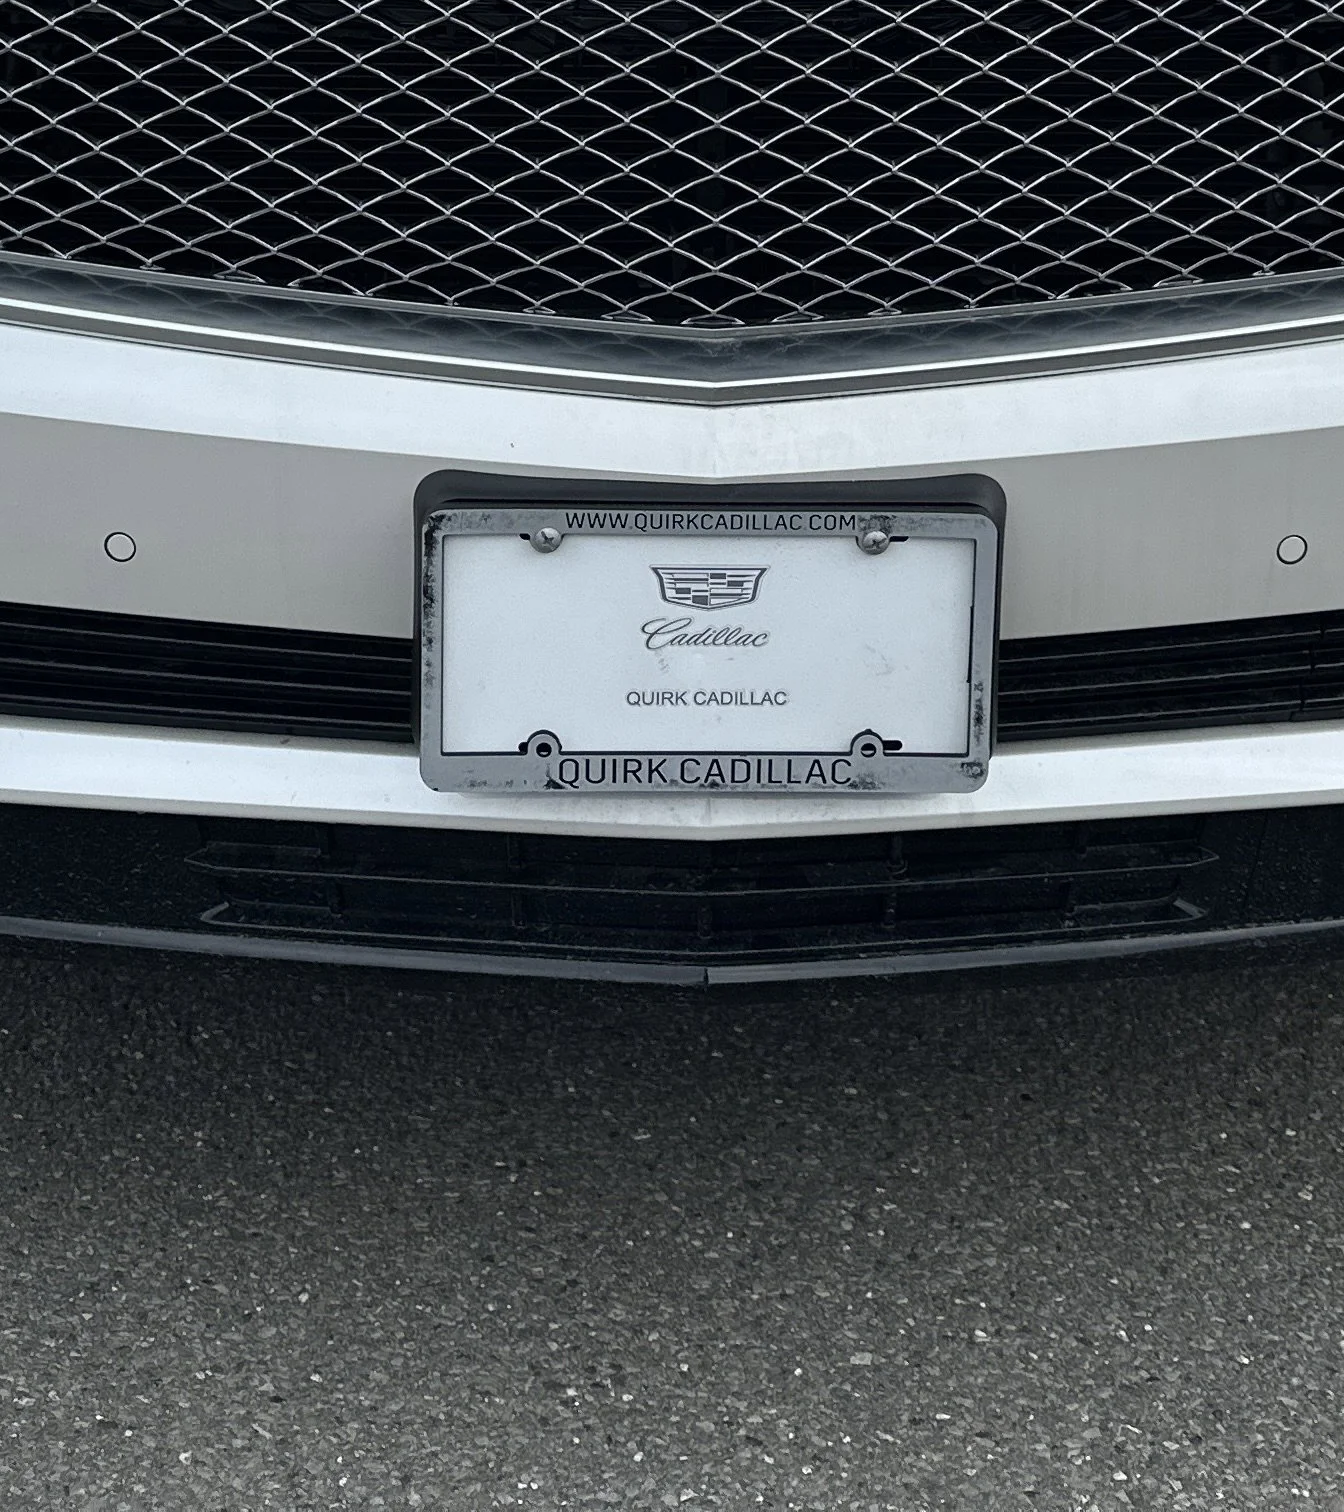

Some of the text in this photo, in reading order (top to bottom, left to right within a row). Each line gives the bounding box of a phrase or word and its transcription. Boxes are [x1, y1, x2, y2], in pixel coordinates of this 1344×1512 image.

[641, 617, 770, 650] Cadillac
[626, 691, 788, 707] QUIRK CADILLAC
[558, 758, 853, 788] QUIRK CADILLAC
